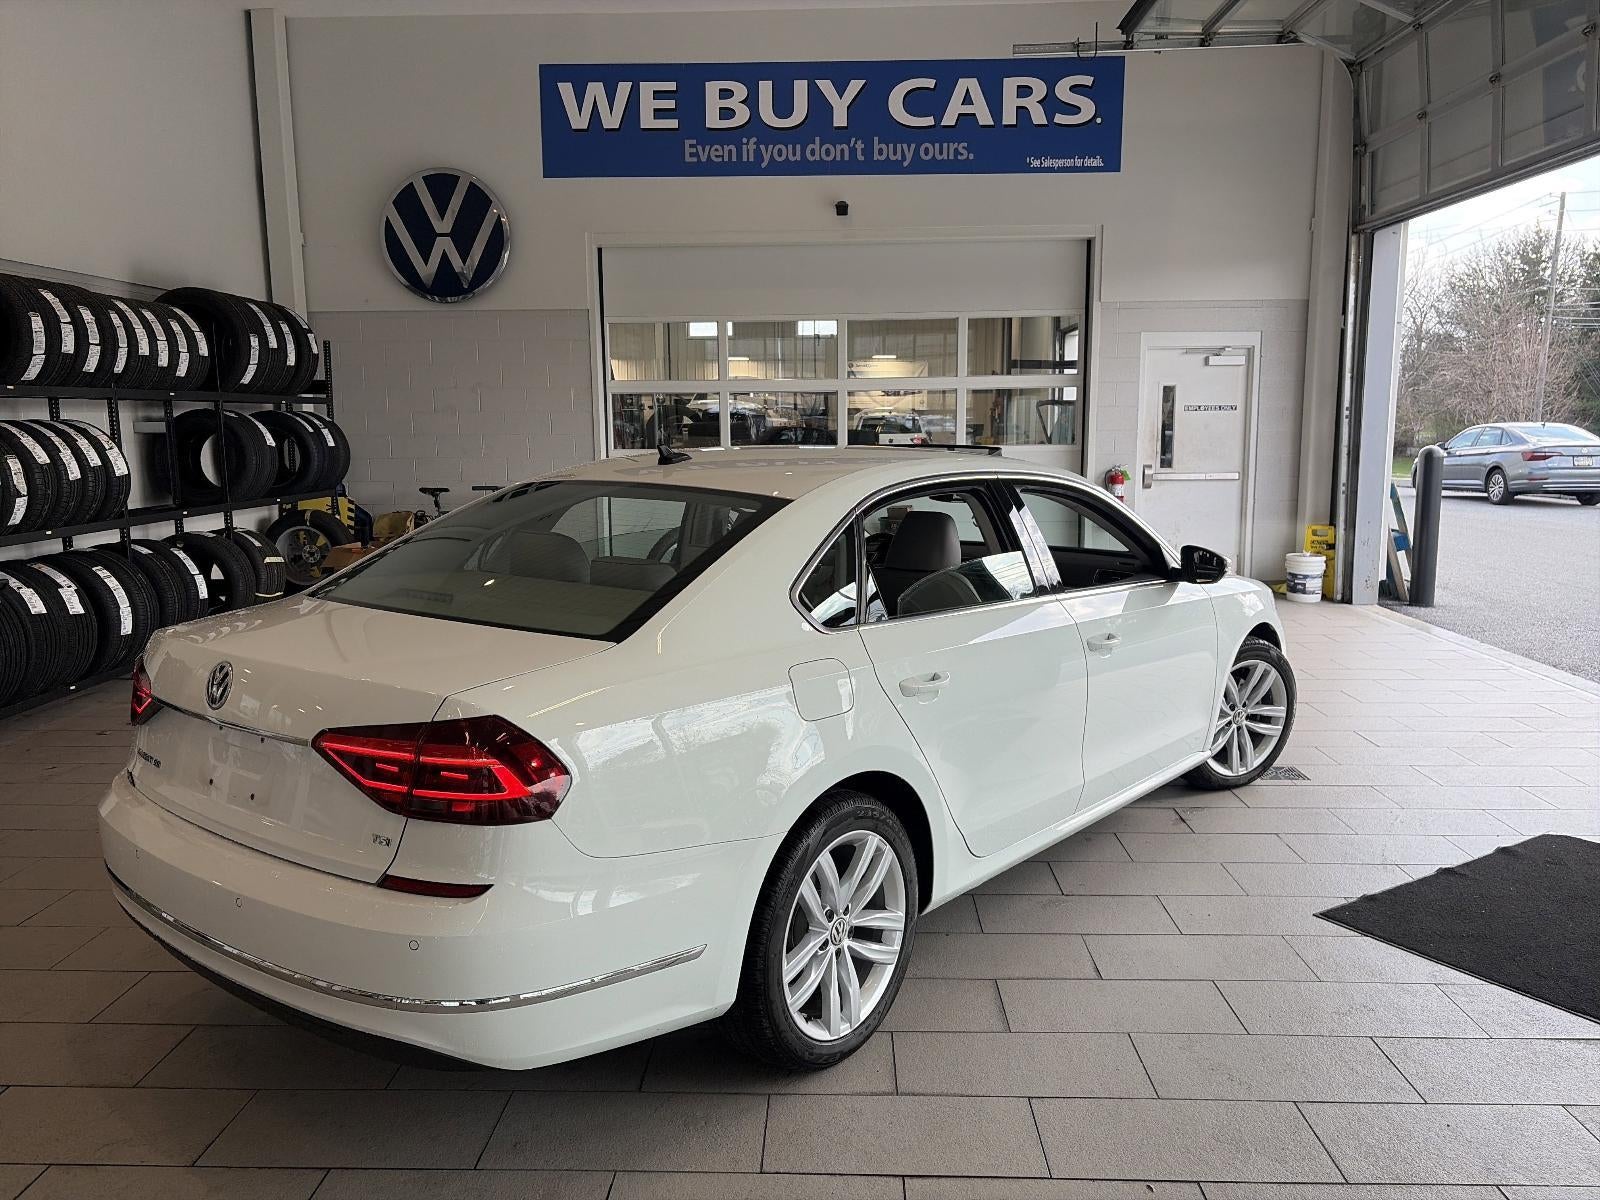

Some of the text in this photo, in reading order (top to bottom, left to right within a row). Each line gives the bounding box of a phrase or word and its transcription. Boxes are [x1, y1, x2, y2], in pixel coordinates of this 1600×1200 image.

[557, 75, 1102, 131] WE BUY CARS.
[684, 136, 974, 168] Even if you don't buy ours.
[1041, 156, 1074, 170] Salesperson
[1075, 156, 1083, 167] for
[1084, 155, 1104, 167] details.
